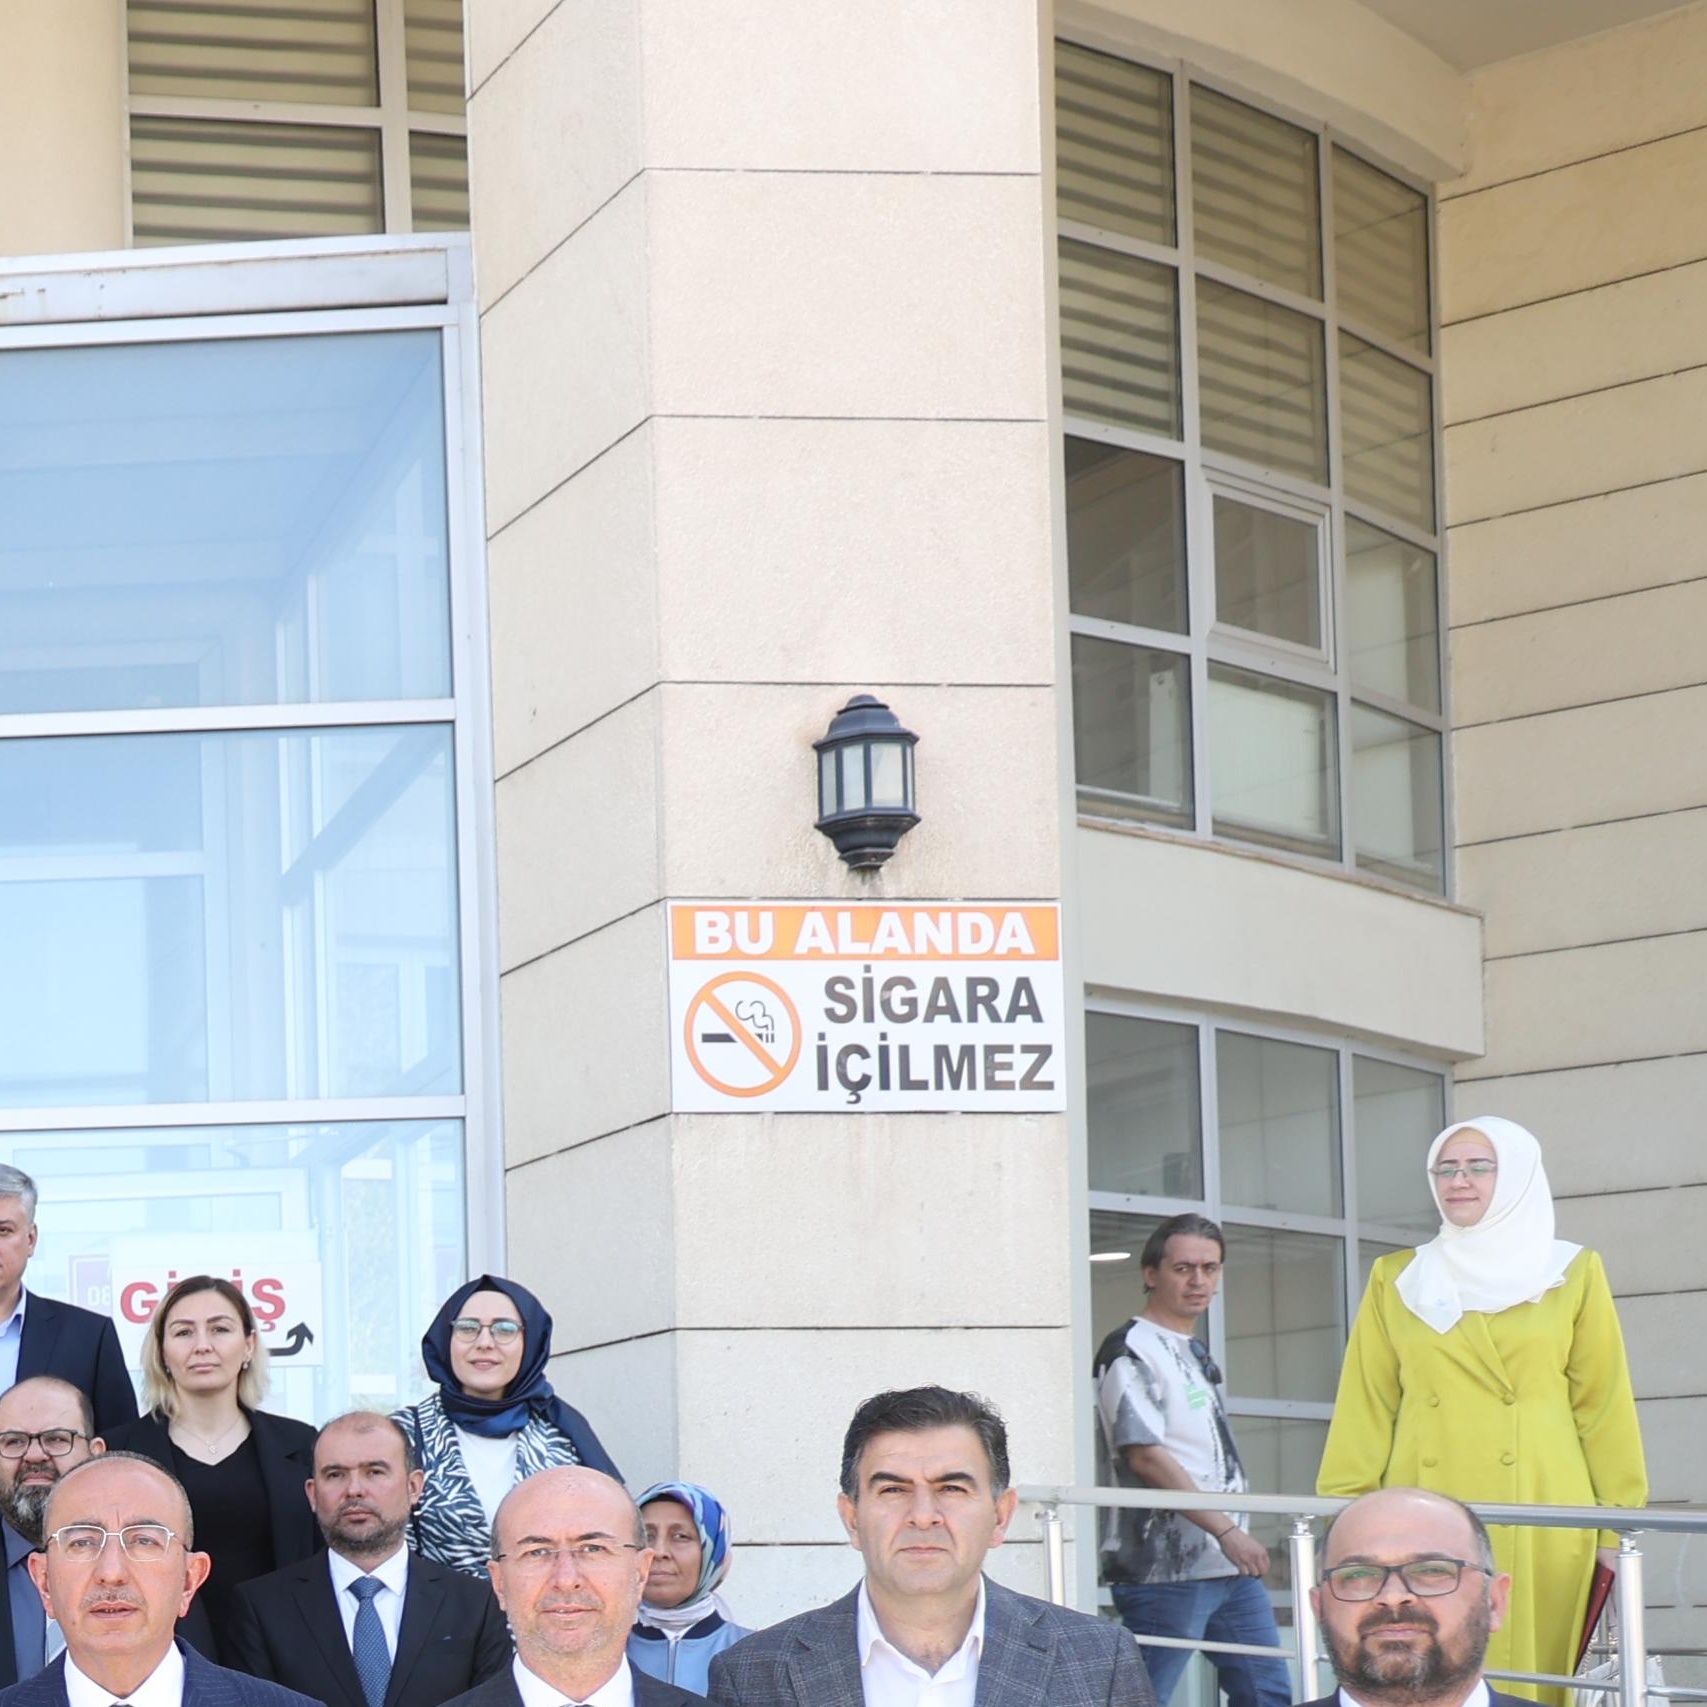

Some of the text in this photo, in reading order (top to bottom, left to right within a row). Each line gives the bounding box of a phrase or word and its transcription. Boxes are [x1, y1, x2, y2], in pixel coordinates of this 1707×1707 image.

[694, 910, 1037, 955] BU ALANDA
[824, 964, 1044, 1024] SİGARA
[816, 1031, 1055, 1105] İÇİLMEZ
